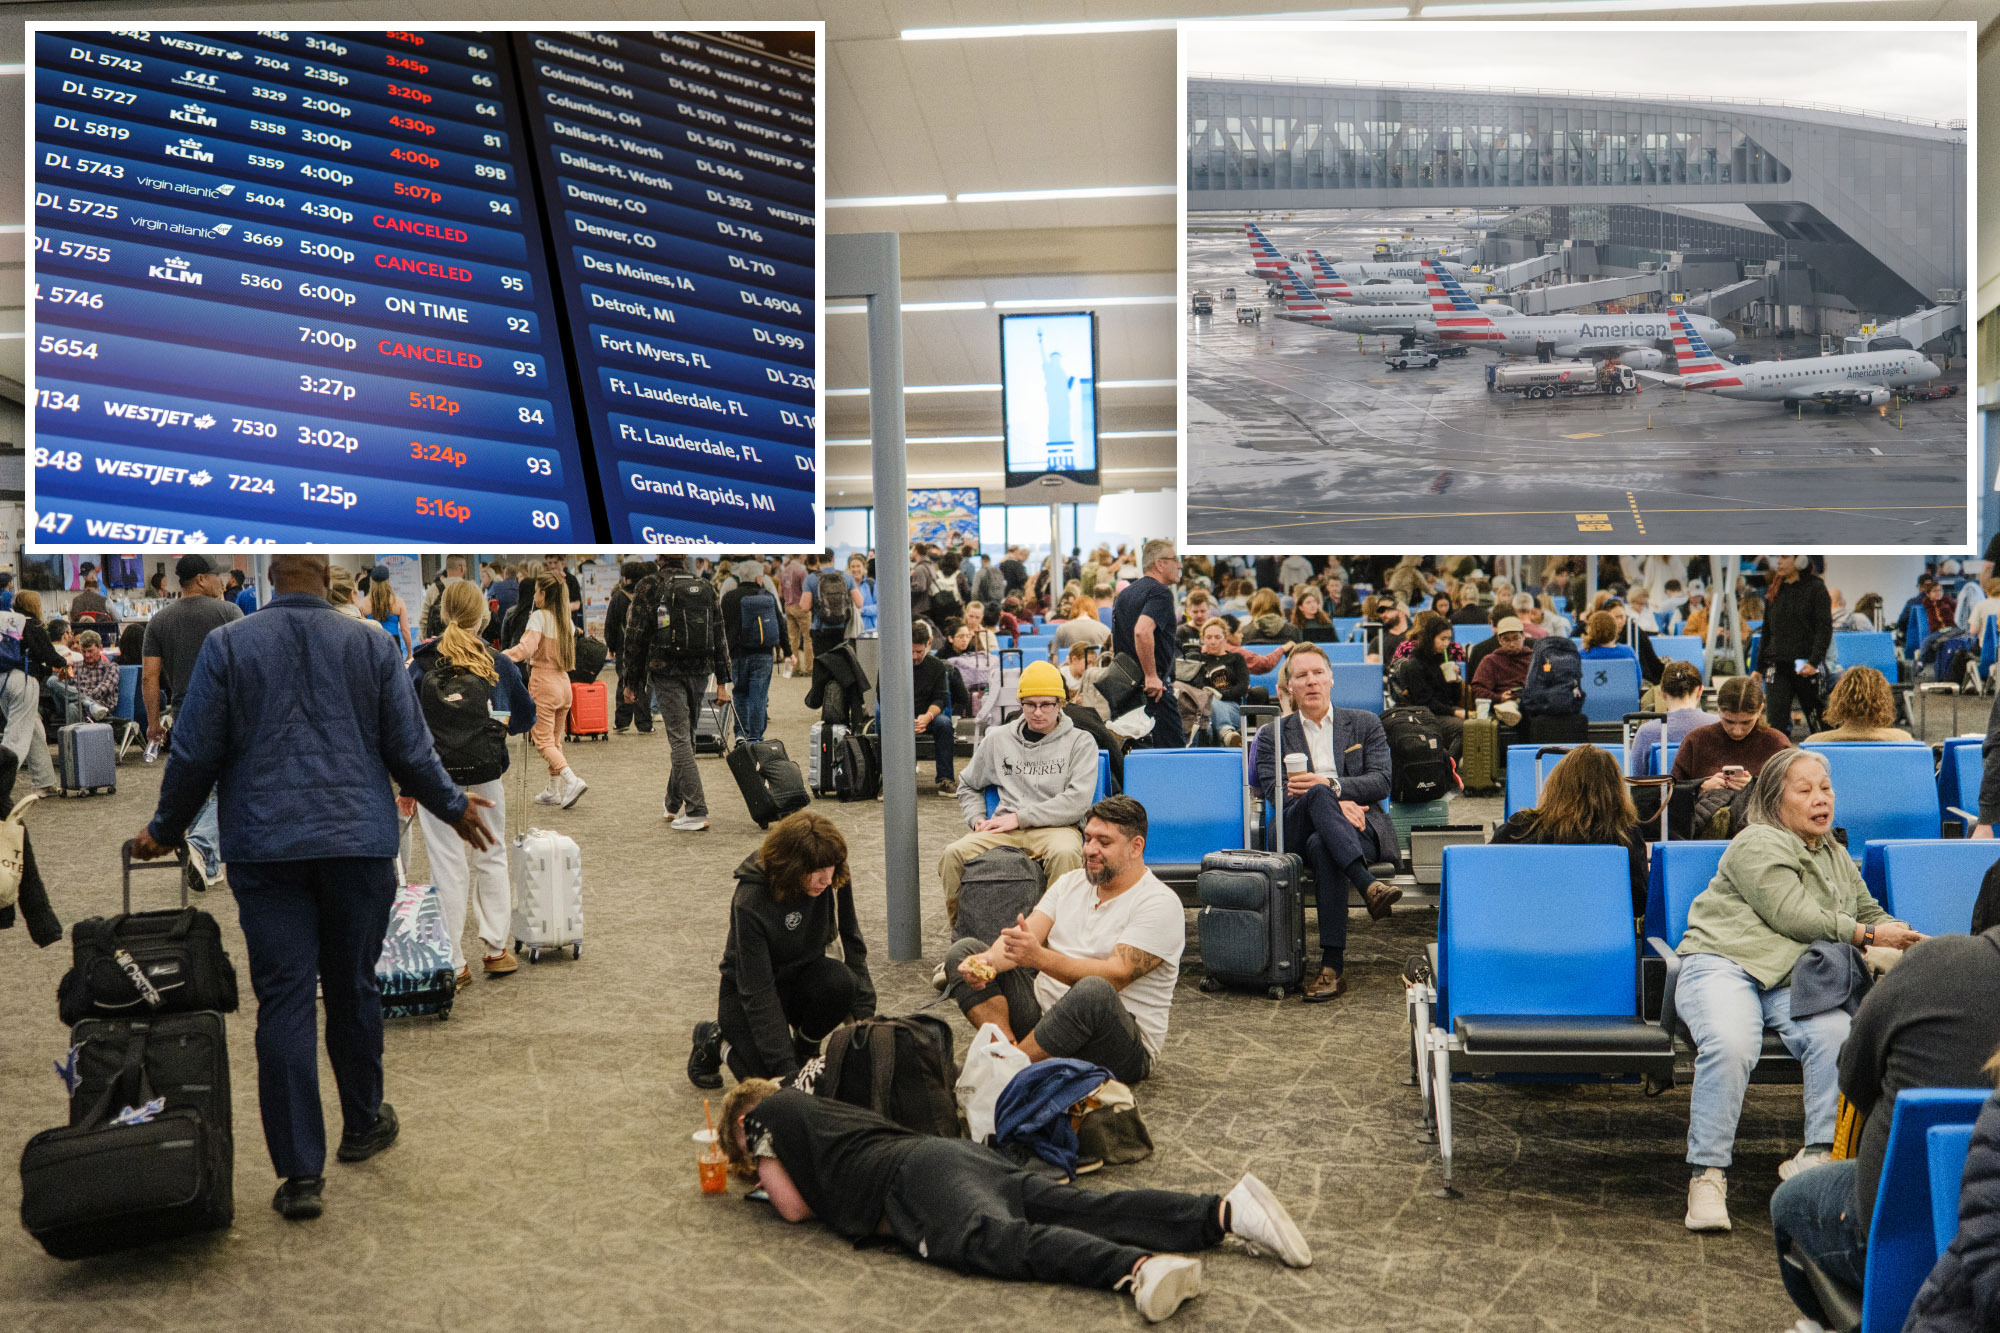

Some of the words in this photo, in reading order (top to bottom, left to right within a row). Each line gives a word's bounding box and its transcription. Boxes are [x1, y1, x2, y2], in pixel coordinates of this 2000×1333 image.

[306, 37, 347, 56] 3:14p
[387, 55, 428, 74] 3:45p
[472, 75, 492, 87] 66
[387, 31, 424, 45] 5:21p
[468, 47, 487, 59] 86
[535, 37, 602, 67] Cleveland,
[603, 59, 624, 72] OH
[669, 78, 686, 90] DL
[661, 53, 677, 65] DL
[71, 48, 94, 62] DL
[99, 54, 142, 72] 5742
[178, 71, 218, 88] SAS
[253, 87, 287, 101] 3329
[303, 97, 351, 117] 2:00p
[389, 116, 435, 135] 4:30p
[484, 135, 500, 147] 81
[160, 36, 226, 56] WESTJET
[255, 56, 289, 71] 7504
[305, 66, 348, 86] 2:35p
[388, 84, 432, 104] 3:20p
[476, 104, 496, 116] 64
[541, 63, 612, 97] Columbus,
[611, 86, 633, 99] OH
[678, 104, 696, 117] DL
[63, 81, 87, 96] DL
[92, 87, 137, 104] 5727
[170, 107, 217, 127] KLM
[251, 120, 286, 135] 5358
[302, 130, 352, 151] 3:00p
[390, 148, 439, 168] 4:00p
[547, 91, 619, 121] Columbus,
[619, 113, 641, 127] OH
[687, 131, 705, 144] DL
[54, 116, 79, 131] DL
[85, 122, 129, 140] 5819
[165, 142, 213, 162] KLM
[248, 155, 284, 169] 5359
[301, 165, 353, 186] 4:00p
[394, 182, 441, 203] 5:07p
[490, 201, 512, 215] 94
[554, 122, 618, 148] Dallas-Ft.
[620, 140, 663, 160] Worth
[697, 160, 716, 173] DL
[717, 166, 743, 180] 846
[45, 153, 71, 169] DL
[77, 159, 124, 178] 5743
[137, 177, 172, 190] virgin
[174, 183, 222, 200] atlantic
[246, 192, 285, 208] 5404
[301, 202, 353, 223] 4:30p
[373, 215, 467, 242] CANCELED
[561, 153, 627, 178] Dallas-Ft.
[629, 170, 672, 190] Worth
[707, 190, 726, 204] DL
[727, 196, 753, 211] 352
[568, 185, 622, 209] Denver,
[625, 200, 647, 213] CO
[717, 222, 737, 236] DL
[738, 227, 763, 242] 716
[36, 193, 62, 209] DL
[68, 199, 118, 219] 5725
[131, 217, 167, 230] virgin
[168, 222, 217, 240] atlantic
[243, 232, 283, 247] 3669
[300, 241, 354, 263] 5:00p
[375, 254, 472, 281] CANCELED
[501, 276, 523, 291] 95
[575, 219, 631, 244] Denver,
[634, 234, 656, 248] CO
[729, 256, 749, 270] DL
[750, 261, 775, 276] 710
[59, 241, 111, 262] 5755
[149, 263, 202, 285] KLM
[241, 274, 282, 290] 5360
[299, 283, 356, 306] 6:00p
[386, 297, 415, 314] ON
[420, 302, 468, 323] TIME
[507, 317, 530, 333] 92
[583, 256, 613, 272] Des
[616, 263, 675, 288] Moines,
[677, 277, 695, 291] IA
[741, 291, 762, 306] DL
[764, 297, 801, 314] 4904
[1388, 265, 1424, 277] Ameri
[50, 287, 103, 309] 5746
[299, 327, 356, 352] 7:00p
[378, 340, 482, 368] CANCELED
[514, 361, 536, 377] 93
[592, 294, 651, 319] Detroit,
[654, 307, 675, 323] MI
[753, 328, 775, 344] DL
[776, 334, 804, 349] 999
[1579, 321, 1667, 338] American
[39, 336, 98, 359] 5654
[300, 376, 355, 400] 3:27p
[410, 392, 459, 416] 5:12p
[519, 408, 544, 424] 84
[600, 335, 633, 353] Fort
[636, 342, 689, 366] Myers,
[692, 353, 711, 368] FL
[766, 368, 789, 384] DL
[1847, 368, 1880, 379] American
[1882, 367, 1901, 377] Eagle
[610, 378, 631, 395] Ft.
[634, 383, 726, 414] Lauderdale,
[728, 400, 748, 416] FL
[780, 410, 803, 427] DL
[104, 401, 194, 427] WESTJET
[232, 419, 277, 438] 7530
[298, 427, 358, 453] 3:02p
[410, 442, 466, 467] 3:24p
[527, 458, 551, 475] 93
[620, 424, 642, 441] Ft.
[645, 429, 740, 461] Lauderdale,
[742, 446, 762, 462] FL
[35, 448, 82, 472] 848
[96, 458, 189, 485] WESTJET
[229, 474, 275, 494] 7224
[300, 482, 357, 509] 1:25p
[416, 497, 470, 523] 5:16p
[532, 510, 559, 529] 80
[631, 474, 684, 496] Grand
[687, 483, 749, 509] Rapids,
[752, 493, 775, 511] MI
[86, 519, 184, 544] WESTJET
[1015, 762, 1065, 776] SURREY
